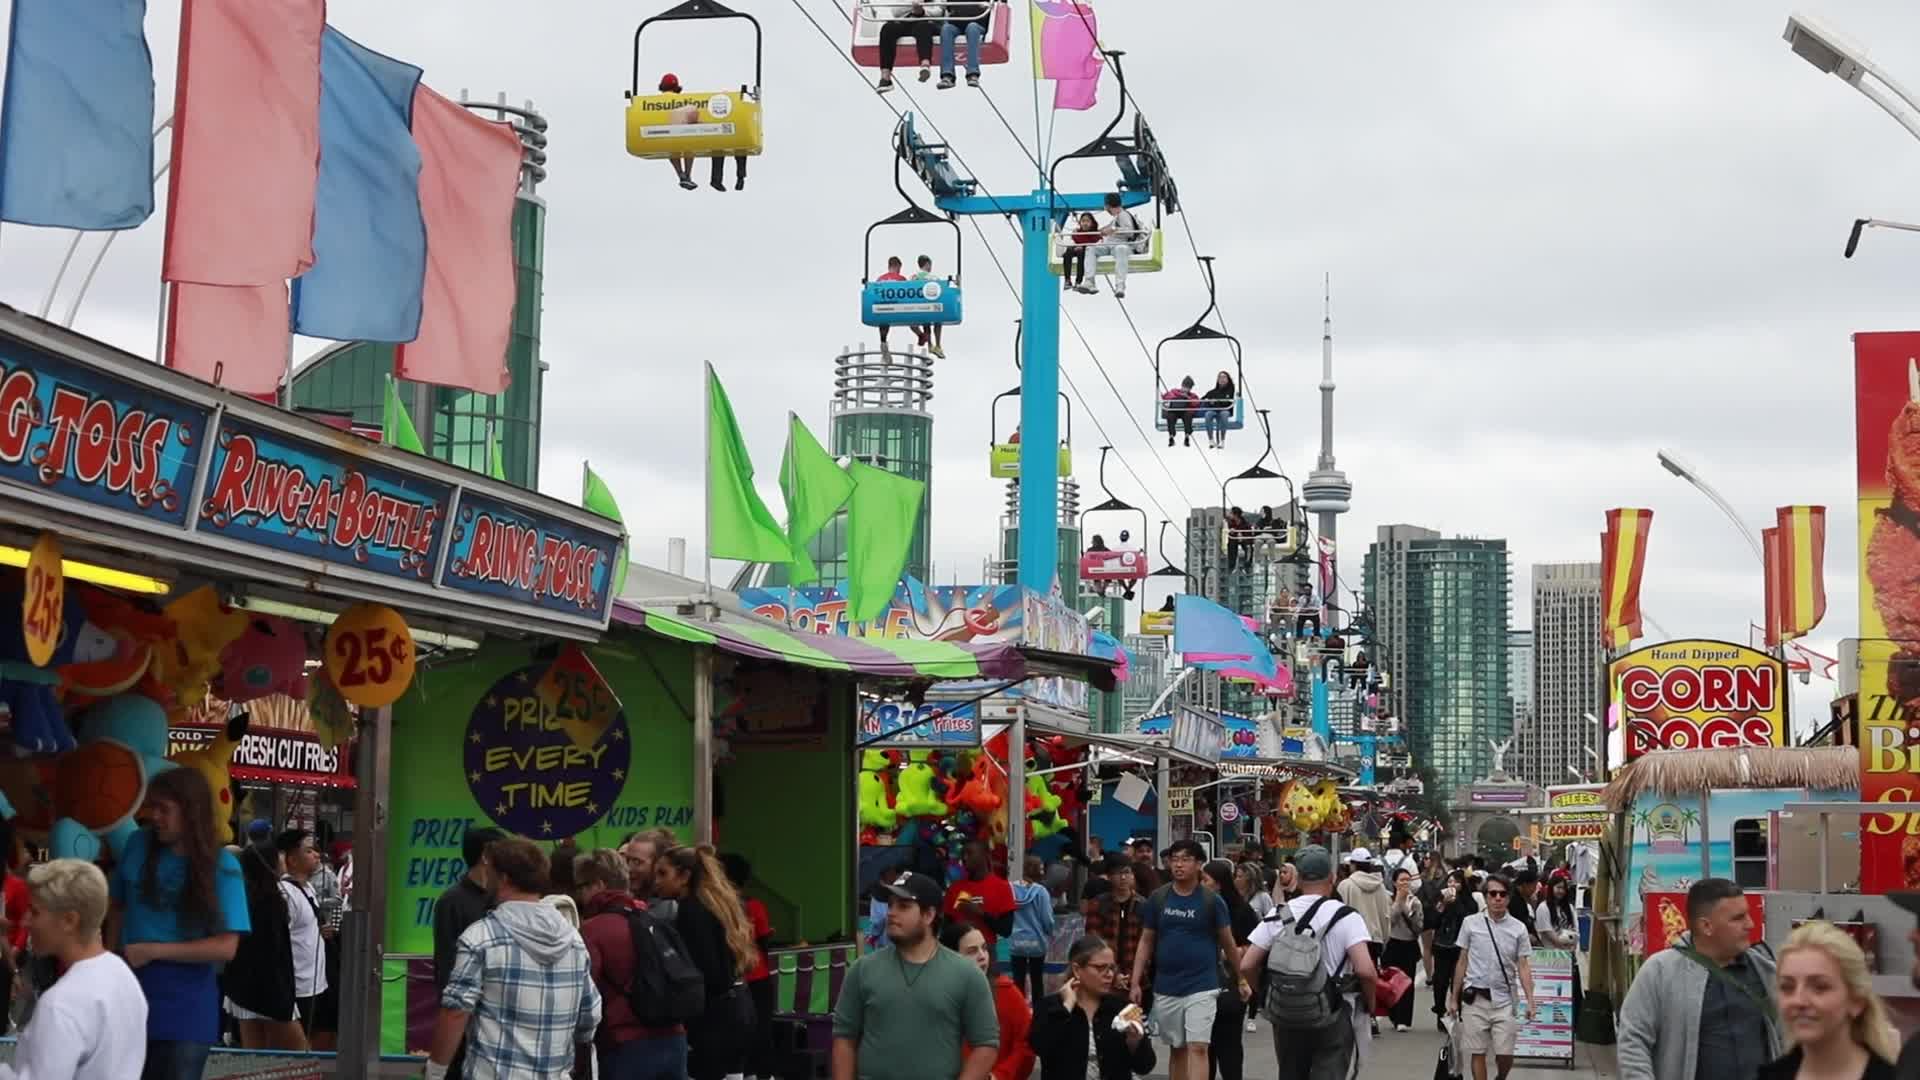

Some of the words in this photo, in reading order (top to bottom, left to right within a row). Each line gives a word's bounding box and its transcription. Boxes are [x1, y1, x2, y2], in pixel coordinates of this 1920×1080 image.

[49, 388, 170, 497] TOSS
[467, 515, 538, 589] RING
[534, 537, 598, 602] TOSS
[335, 627, 408, 687] 25¢
[1651, 650, 1687, 660] Hand
[1692, 649, 1739, 661] Dipped
[1621, 665, 1775, 713] CORN
[168, 731, 203, 741] COLD
[879, 704, 934, 738] BIG
[929, 707, 974, 733] Prizes
[1626, 717, 1773, 758] DOGS
[277, 738, 304, 769] CUT
[484, 743, 608, 773] EVERY
[500, 781, 593, 809] TIME
[1171, 798, 1190, 809] UP
[607, 806, 649, 826] KIDS
[656, 806, 694, 826] PLAY
[406, 857, 467, 889] EVER
